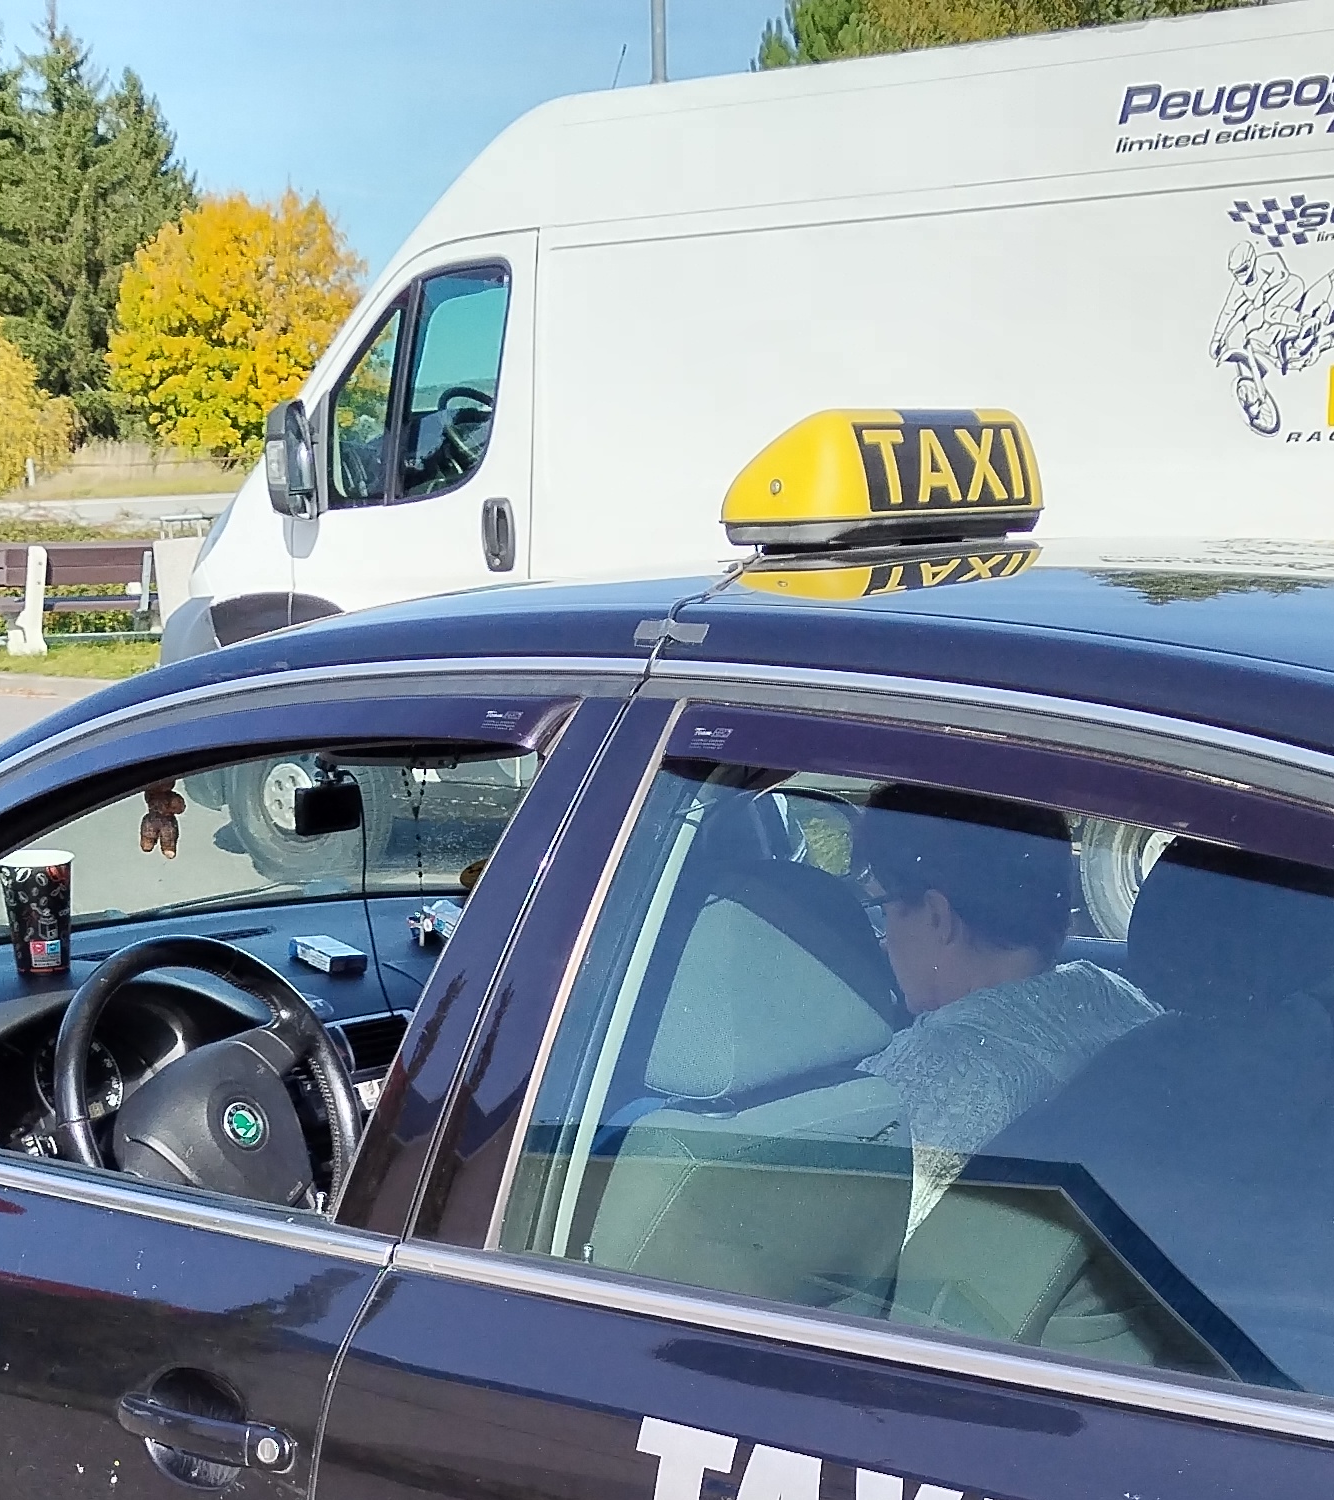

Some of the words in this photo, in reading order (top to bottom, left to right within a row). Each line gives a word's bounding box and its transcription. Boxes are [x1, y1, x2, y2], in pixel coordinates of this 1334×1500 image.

[1116, 129, 1209, 153] limited
[1215, 121, 1315, 144] edition
[862, 428, 1026, 505] TAXI
